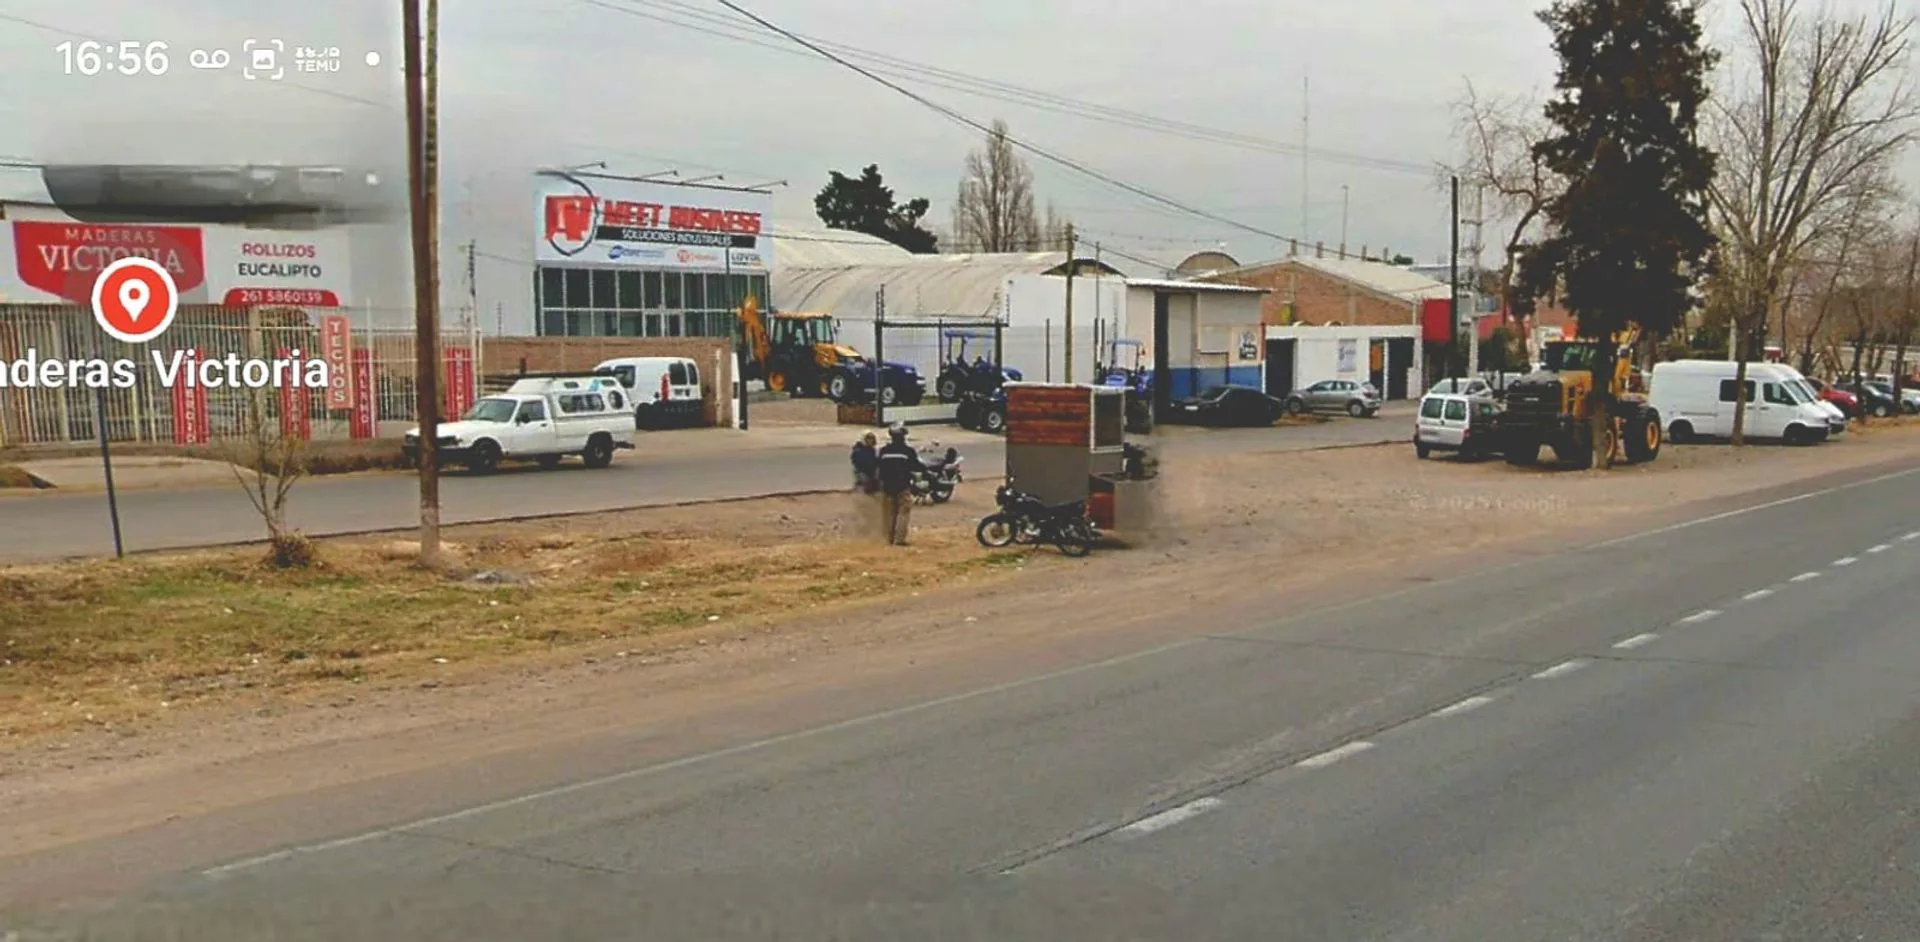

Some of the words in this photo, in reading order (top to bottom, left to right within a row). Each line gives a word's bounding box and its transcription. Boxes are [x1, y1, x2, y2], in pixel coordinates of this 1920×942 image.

[603, 199, 663, 228] MEET
[65, 228, 157, 243] MADERAS
[621, 229, 676, 243] SOLUCIONES
[242, 243, 316, 258] ROLLIZOS
[238, 262, 322, 278] EUCALIPTO
[240, 290, 263, 302] 261
[330, 320, 345, 402] TECHOS
